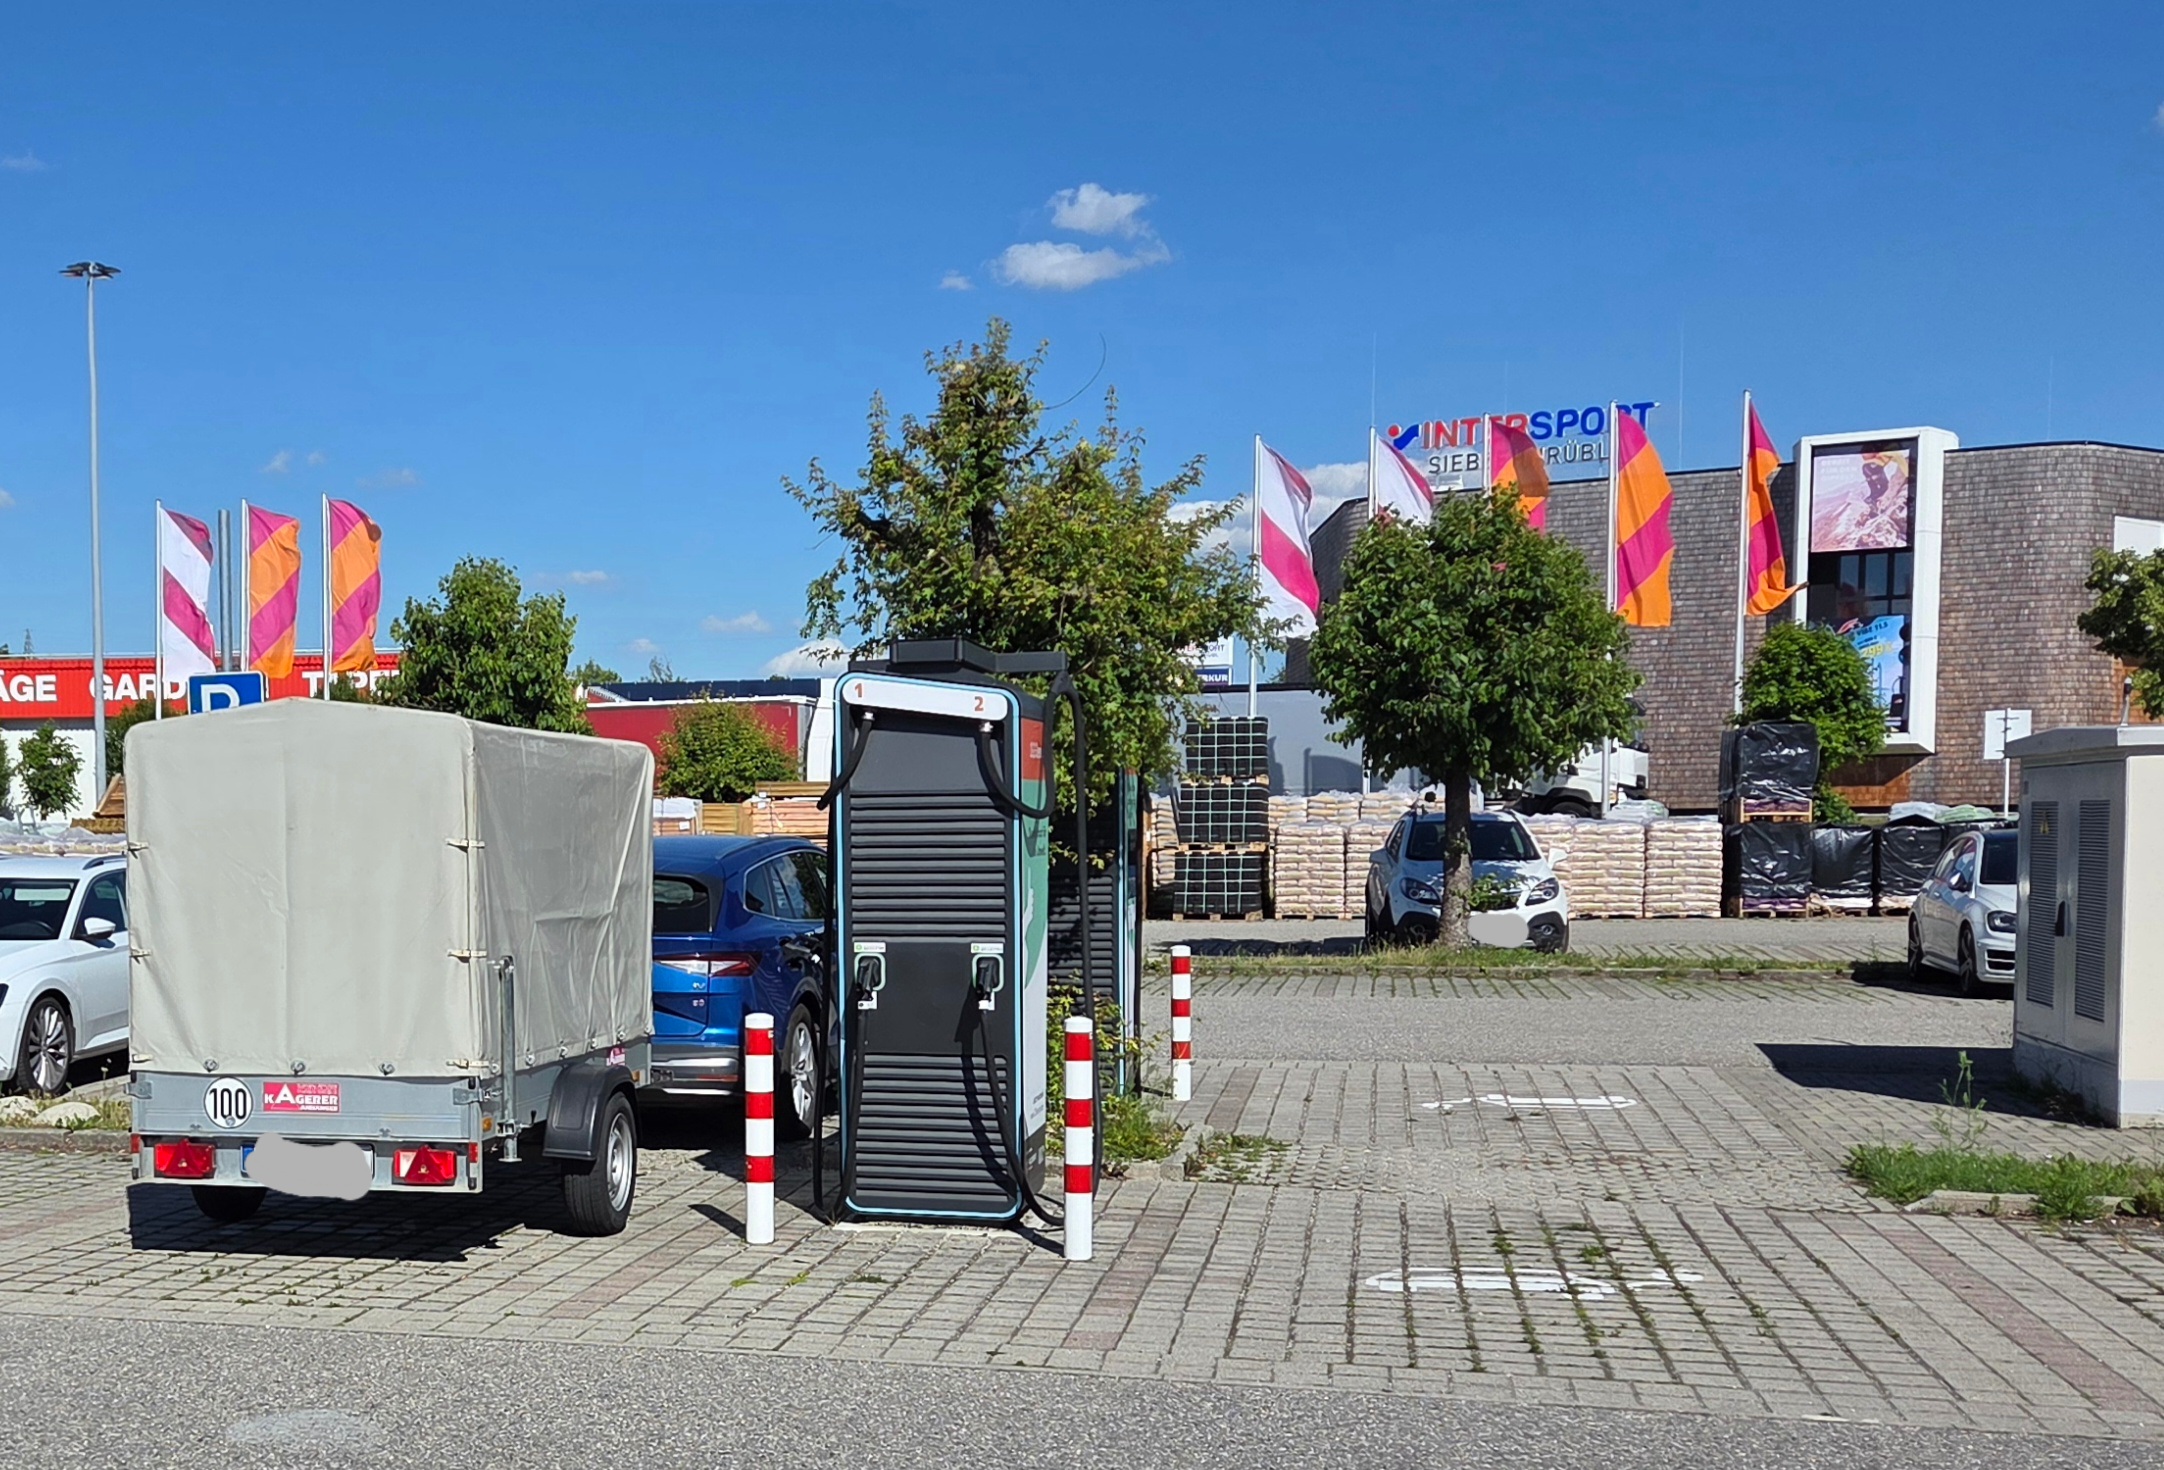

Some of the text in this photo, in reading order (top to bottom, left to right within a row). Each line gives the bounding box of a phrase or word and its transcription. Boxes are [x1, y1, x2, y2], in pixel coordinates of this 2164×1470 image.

[1423, 402, 1655, 450] INTRSPOT
[88, 672, 190, 702] GARD
[854, 683, 863, 698] 1
[974, 696, 984, 711] 2
[208, 1088, 248, 1120] 100
[264, 1083, 338, 1105] KAGERER
